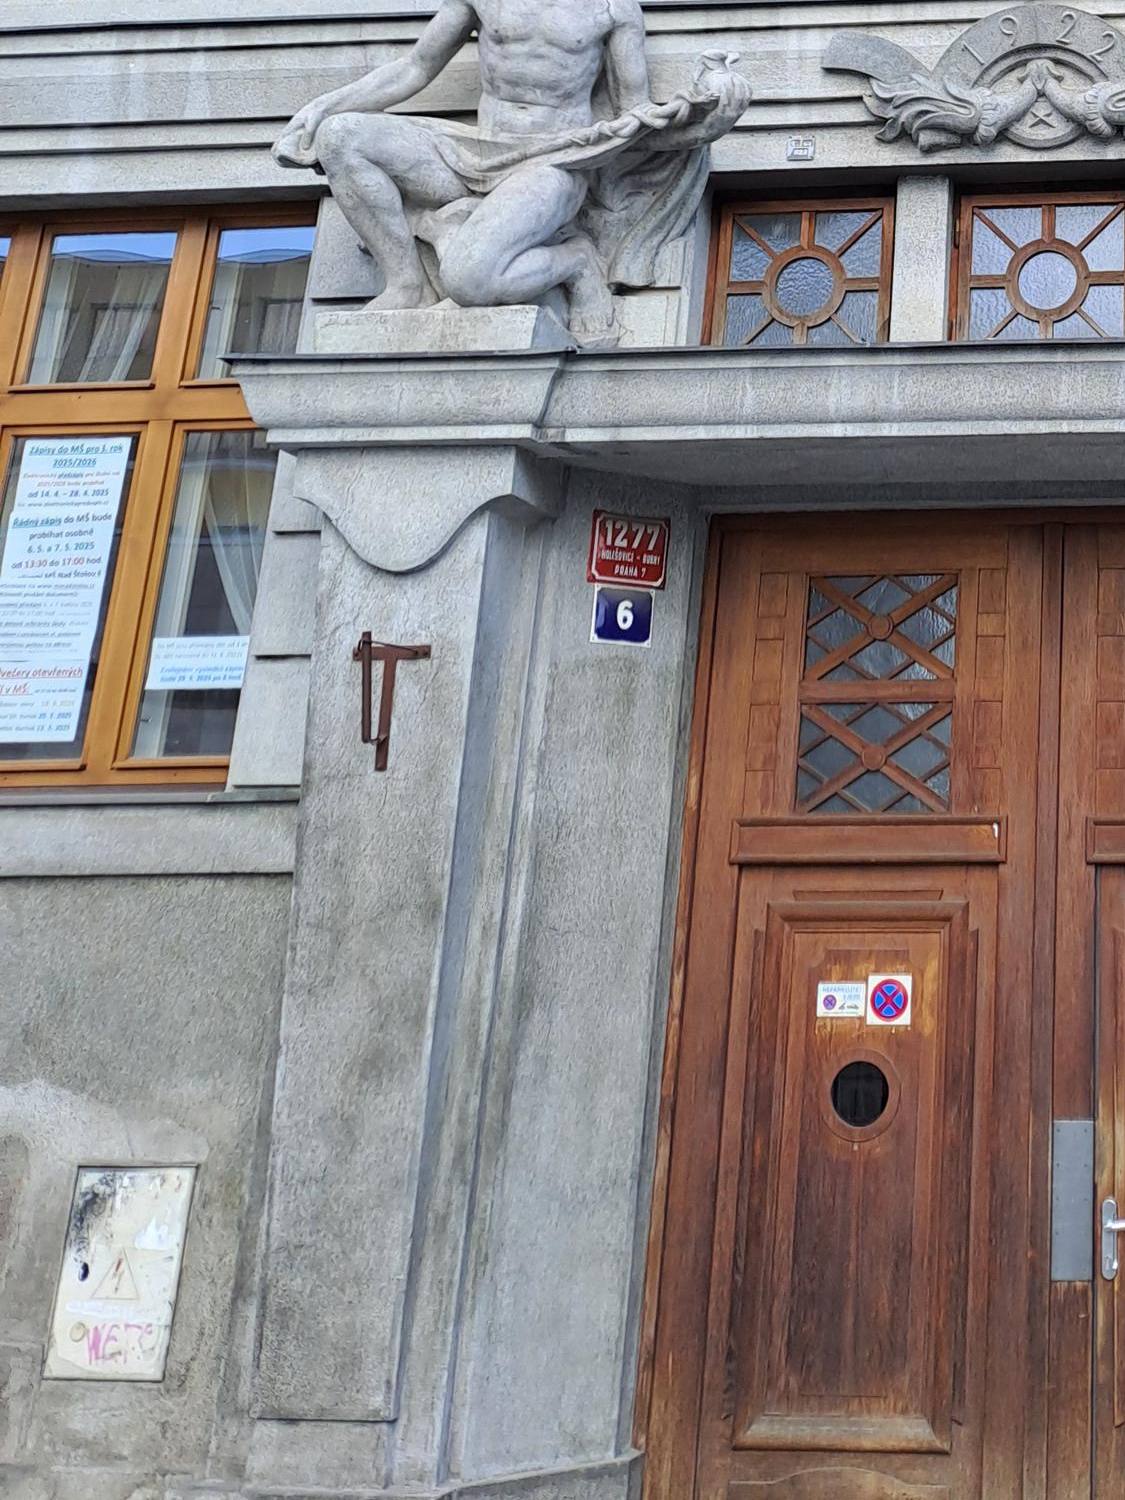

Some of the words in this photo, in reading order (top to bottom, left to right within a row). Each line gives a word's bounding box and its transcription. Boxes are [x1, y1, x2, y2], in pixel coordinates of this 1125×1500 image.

[961, 11, 1116, 65] 1922
[58, 445, 68, 453] do
[70, 443, 84, 453] MŠ
[86, 446, 99, 455] pro
[110, 443, 122, 452] rok
[91, 489, 109, 497] 2025
[64, 515, 74, 523] do
[76, 513, 90, 523] MŠ
[92, 512, 112, 521] bude
[605, 519, 661, 551] 1277
[74, 542, 95, 550] 2025
[11, 561, 22, 569] od
[49, 559, 59, 567] do
[614, 564, 638, 578] PRAHA
[641, 567, 647, 578] 7
[616, 599, 634, 630] 6
